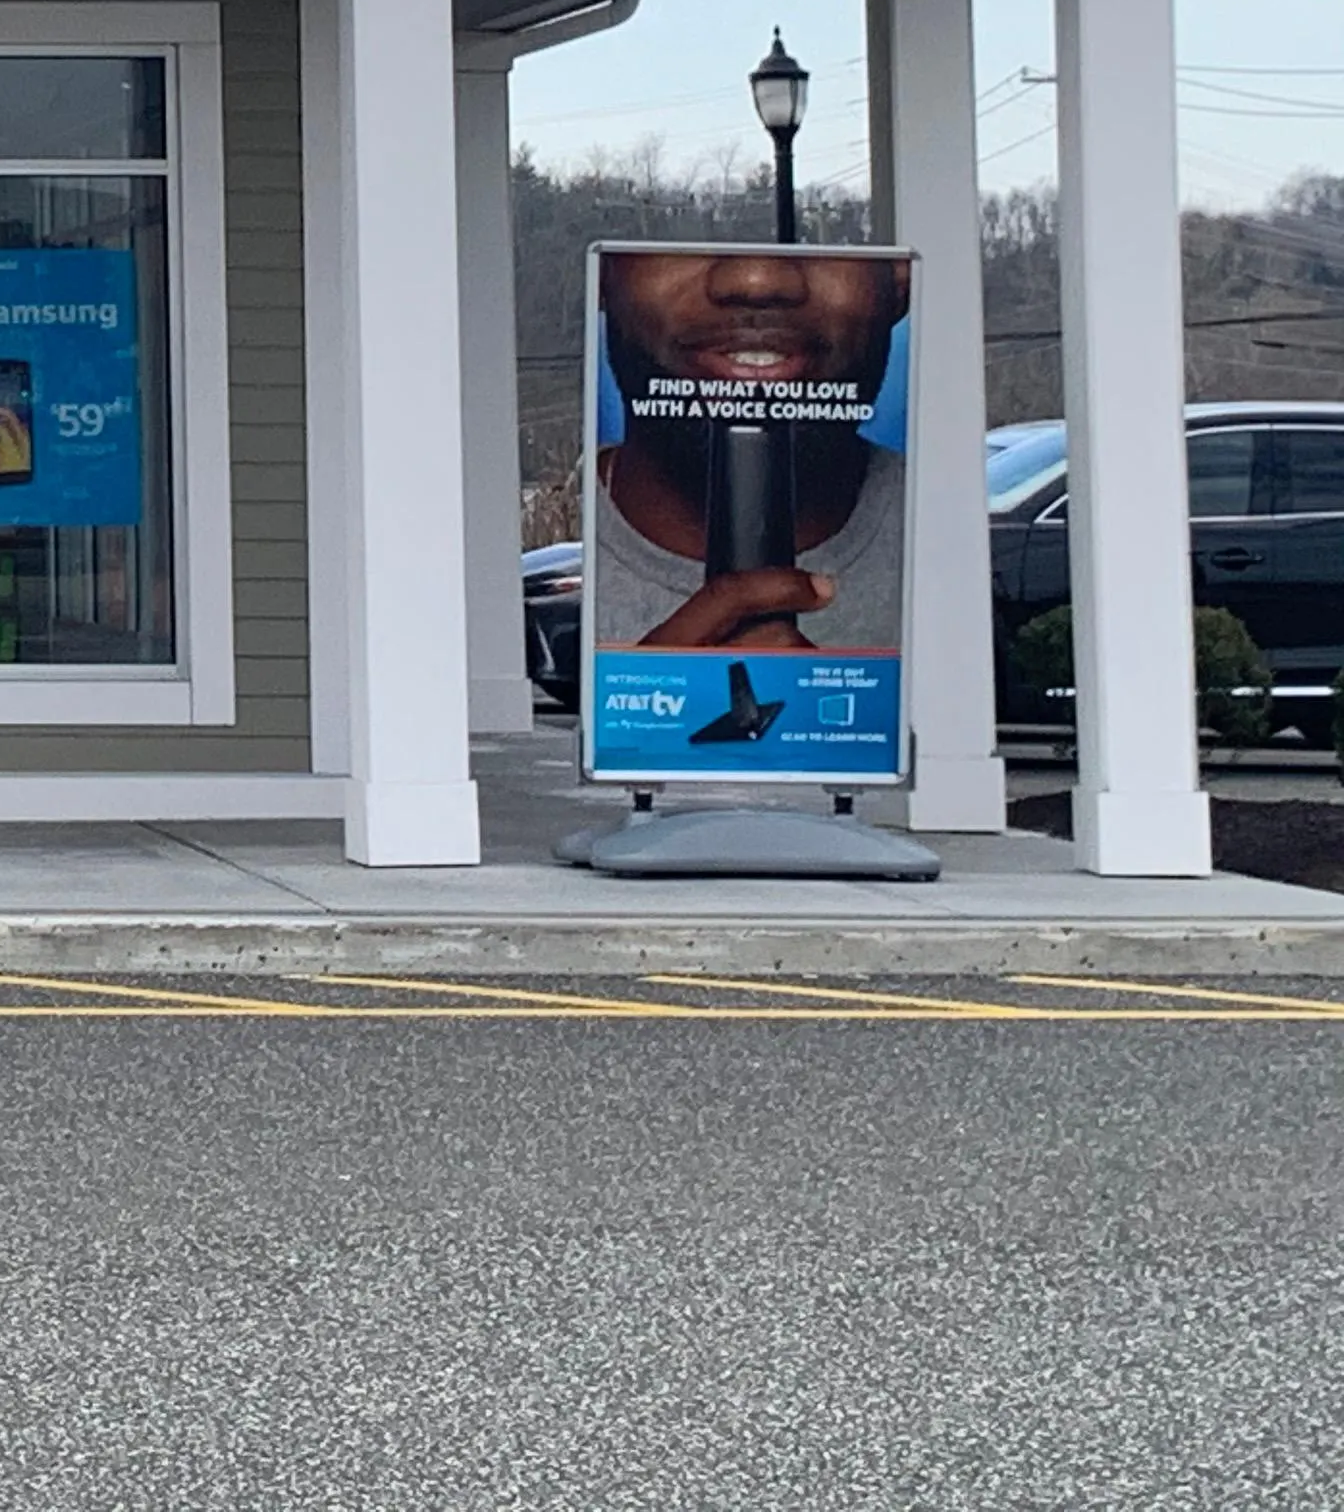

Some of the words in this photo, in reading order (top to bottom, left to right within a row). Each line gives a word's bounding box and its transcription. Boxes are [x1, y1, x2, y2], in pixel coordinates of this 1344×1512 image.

[648, 378, 695, 396] FIND
[699, 380, 757, 397] WHAT
[761, 381, 802, 399] YOU
[806, 382, 858, 400] LOVE
[631, 399, 684, 417] WITH
[687, 401, 703, 417] A
[706, 401, 765, 419] VOICE
[769, 402, 874, 420] COMMAND
[605, 693, 650, 710] AT&T
[652, 690, 687, 716] tv
